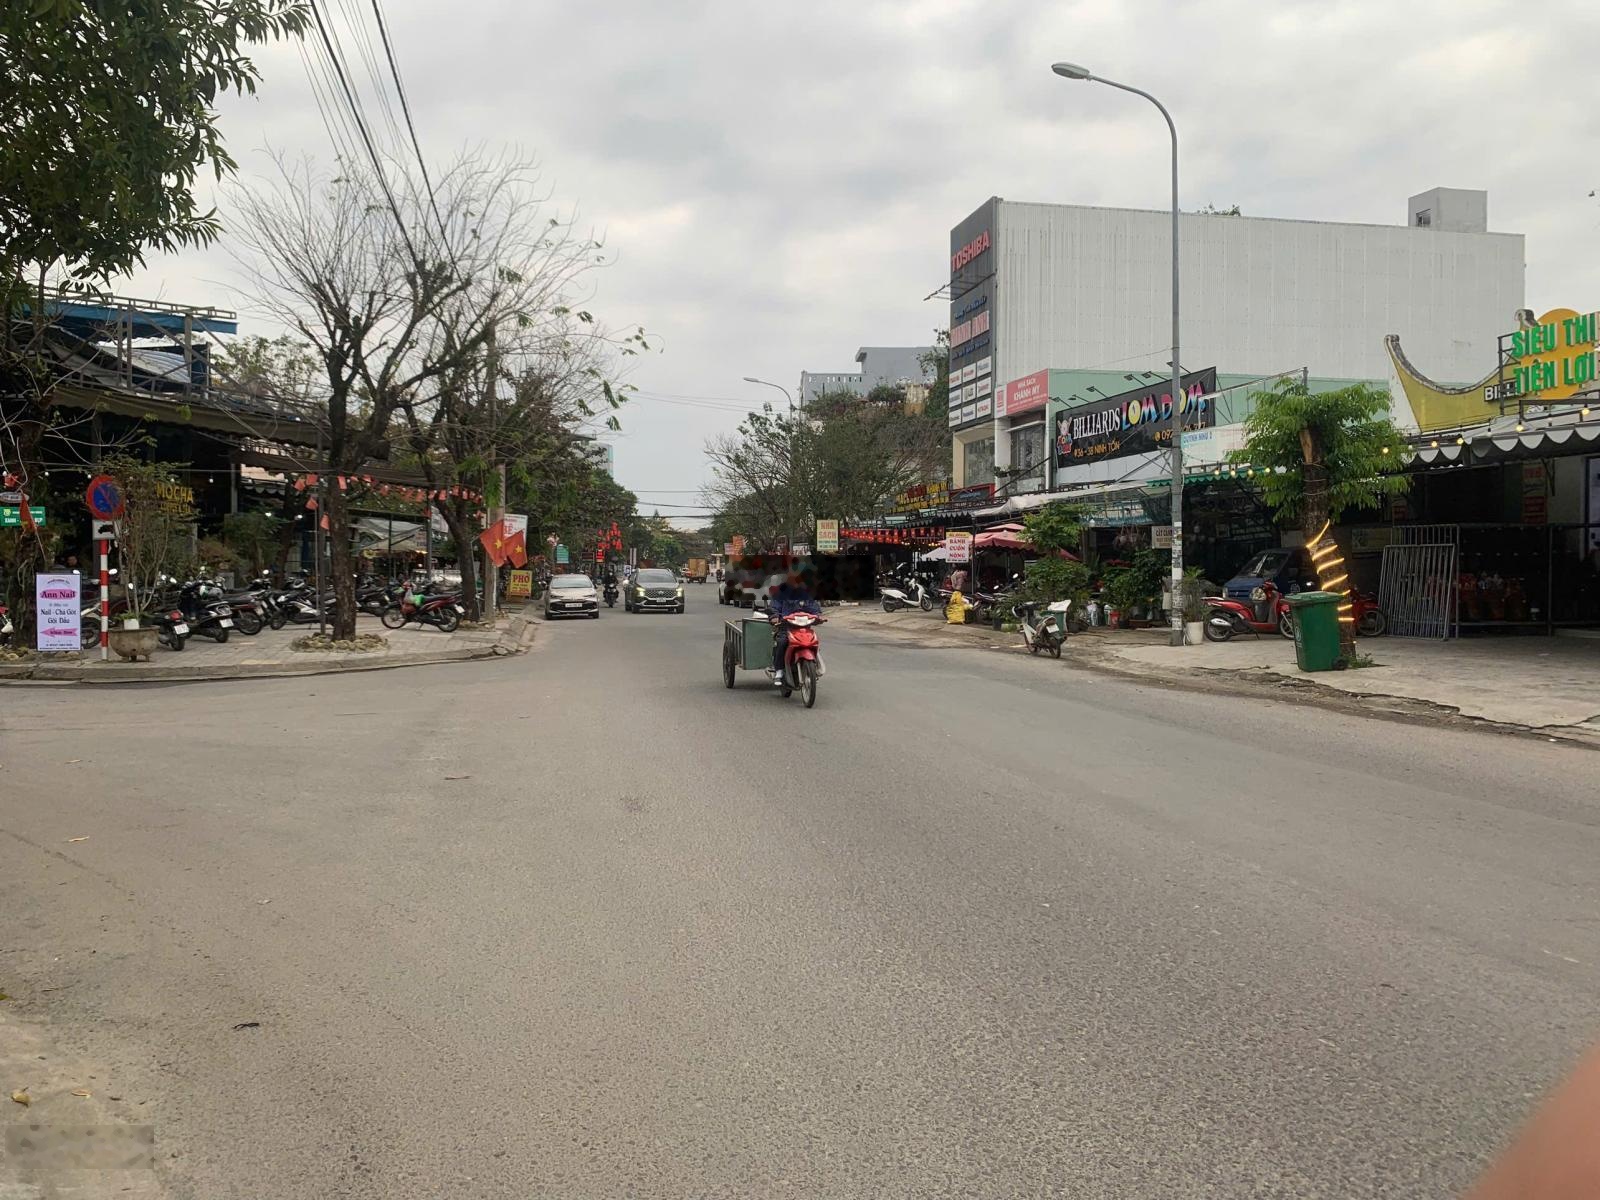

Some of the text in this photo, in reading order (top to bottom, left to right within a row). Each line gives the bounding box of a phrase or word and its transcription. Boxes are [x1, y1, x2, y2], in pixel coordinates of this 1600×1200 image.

[952, 230, 991, 273] TOSHIBA
[1513, 358, 1559, 397] TIỆN
[1073, 406, 1121, 440] BILLIARDS
[1121, 394, 1159, 432] LOM
[59, 591, 76, 599] Nail
